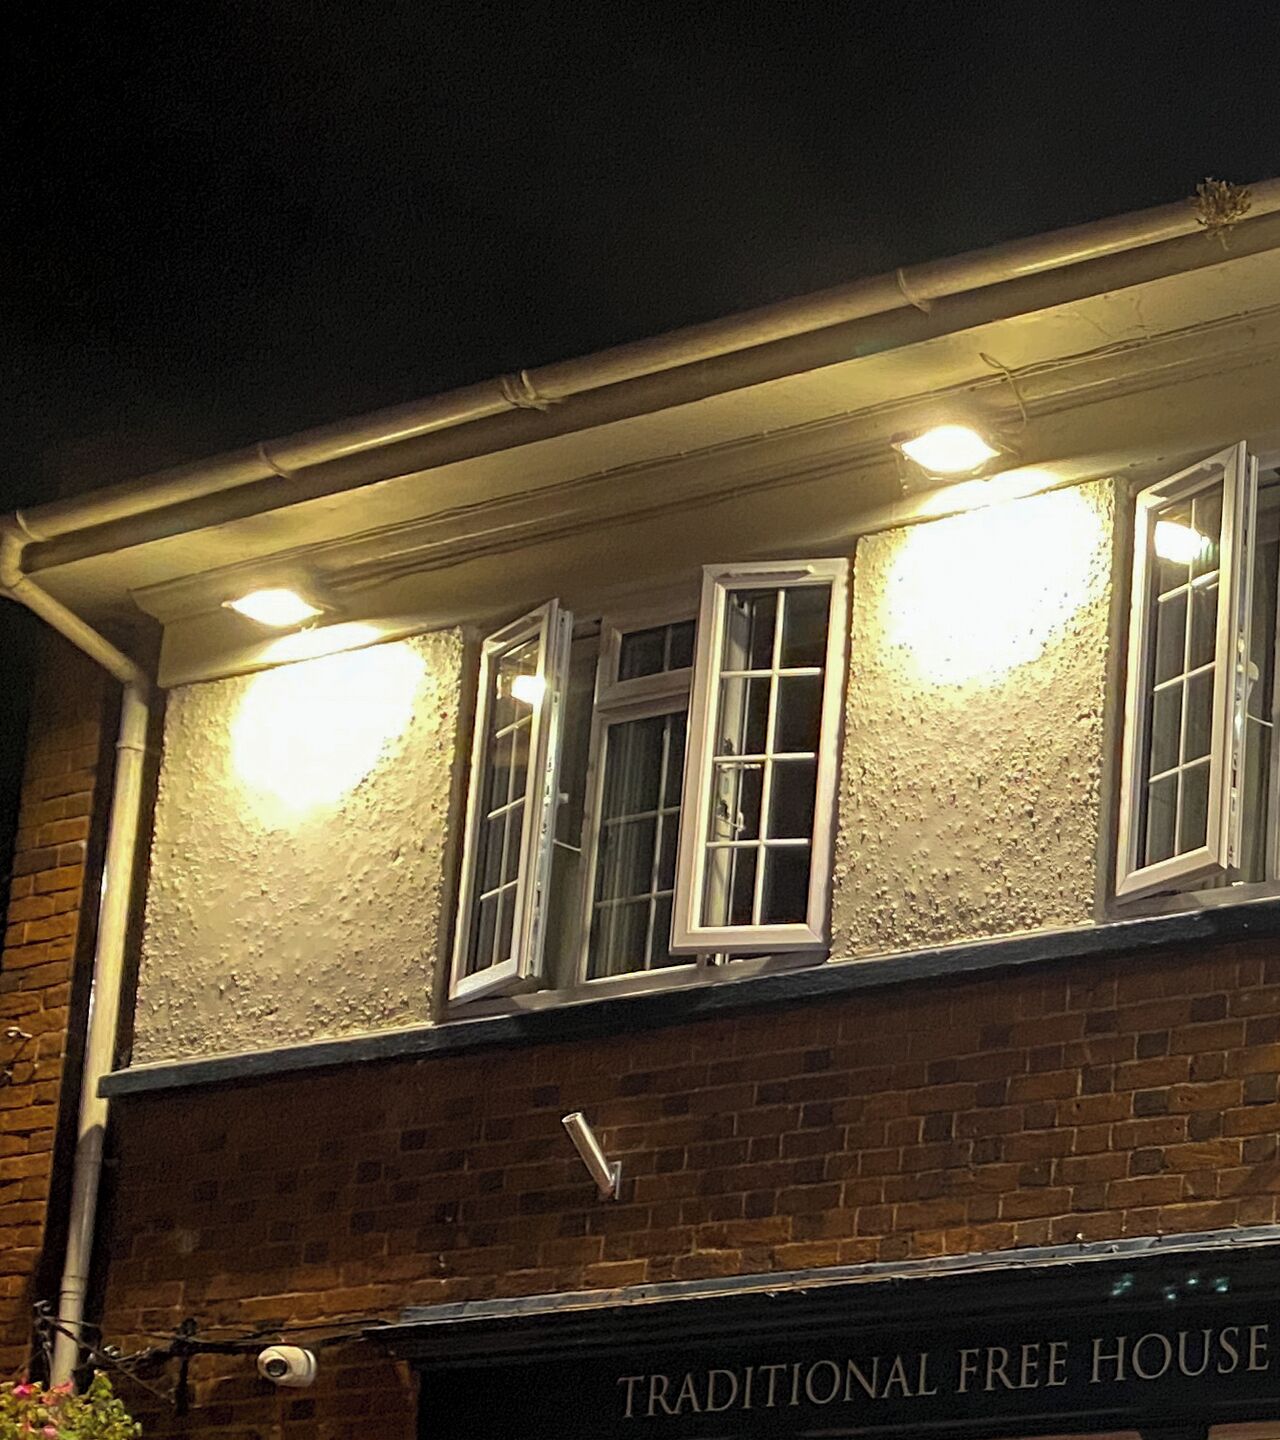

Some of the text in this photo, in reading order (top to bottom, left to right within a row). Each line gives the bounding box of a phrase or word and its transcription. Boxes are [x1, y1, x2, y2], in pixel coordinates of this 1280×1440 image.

[617, 1323, 1271, 1419] TRADITIONAL FREE HOUSE
